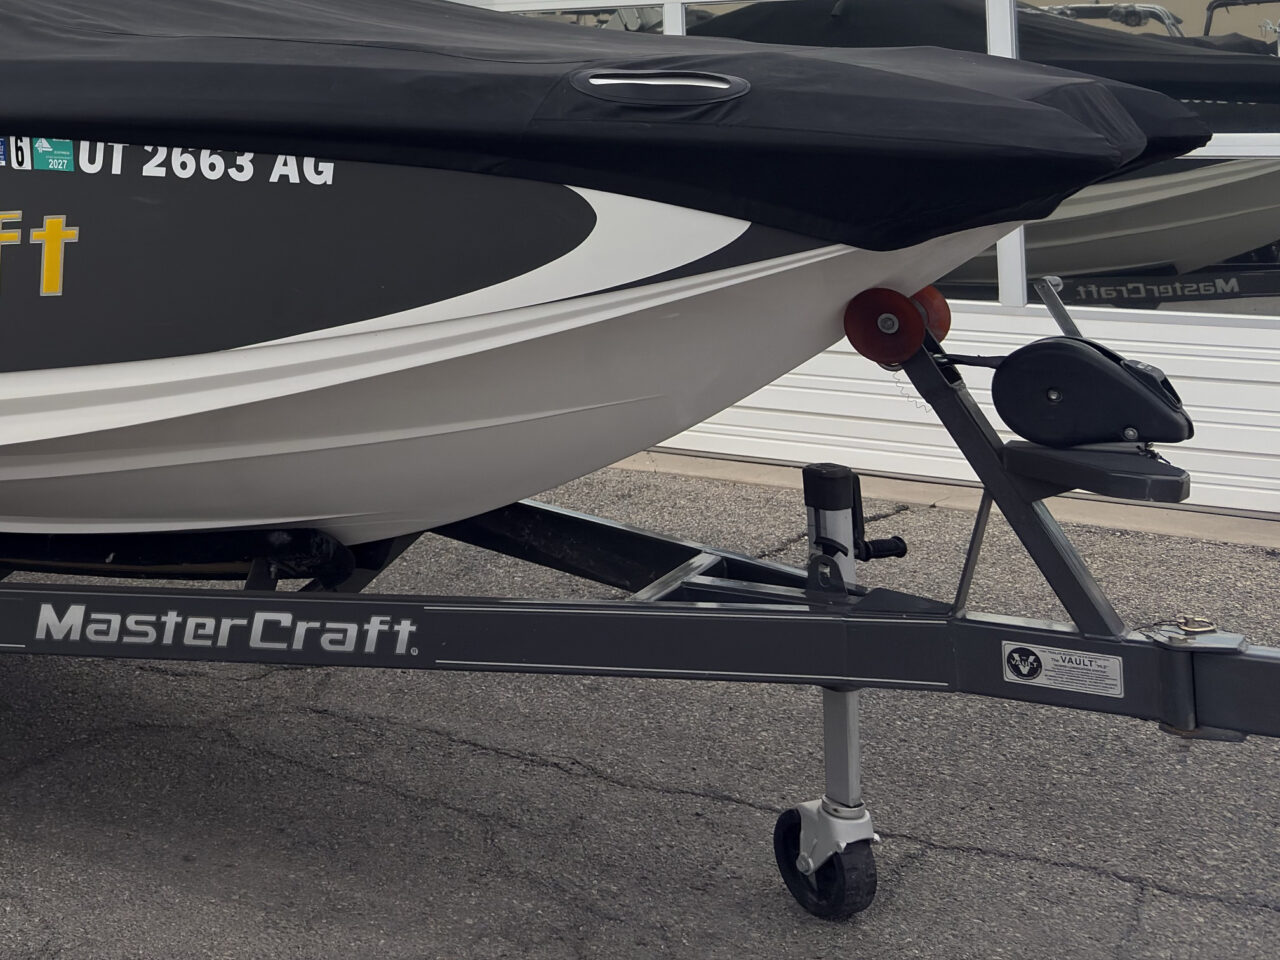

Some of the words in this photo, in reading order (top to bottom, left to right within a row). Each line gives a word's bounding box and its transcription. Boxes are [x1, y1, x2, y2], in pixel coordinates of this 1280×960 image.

[48, 159, 68, 169] 2027
[78, 140, 130, 175] UT
[142, 145, 254, 182] 2663
[269, 154, 335, 185] AG
[1060, 655, 1094, 667] VAULT
